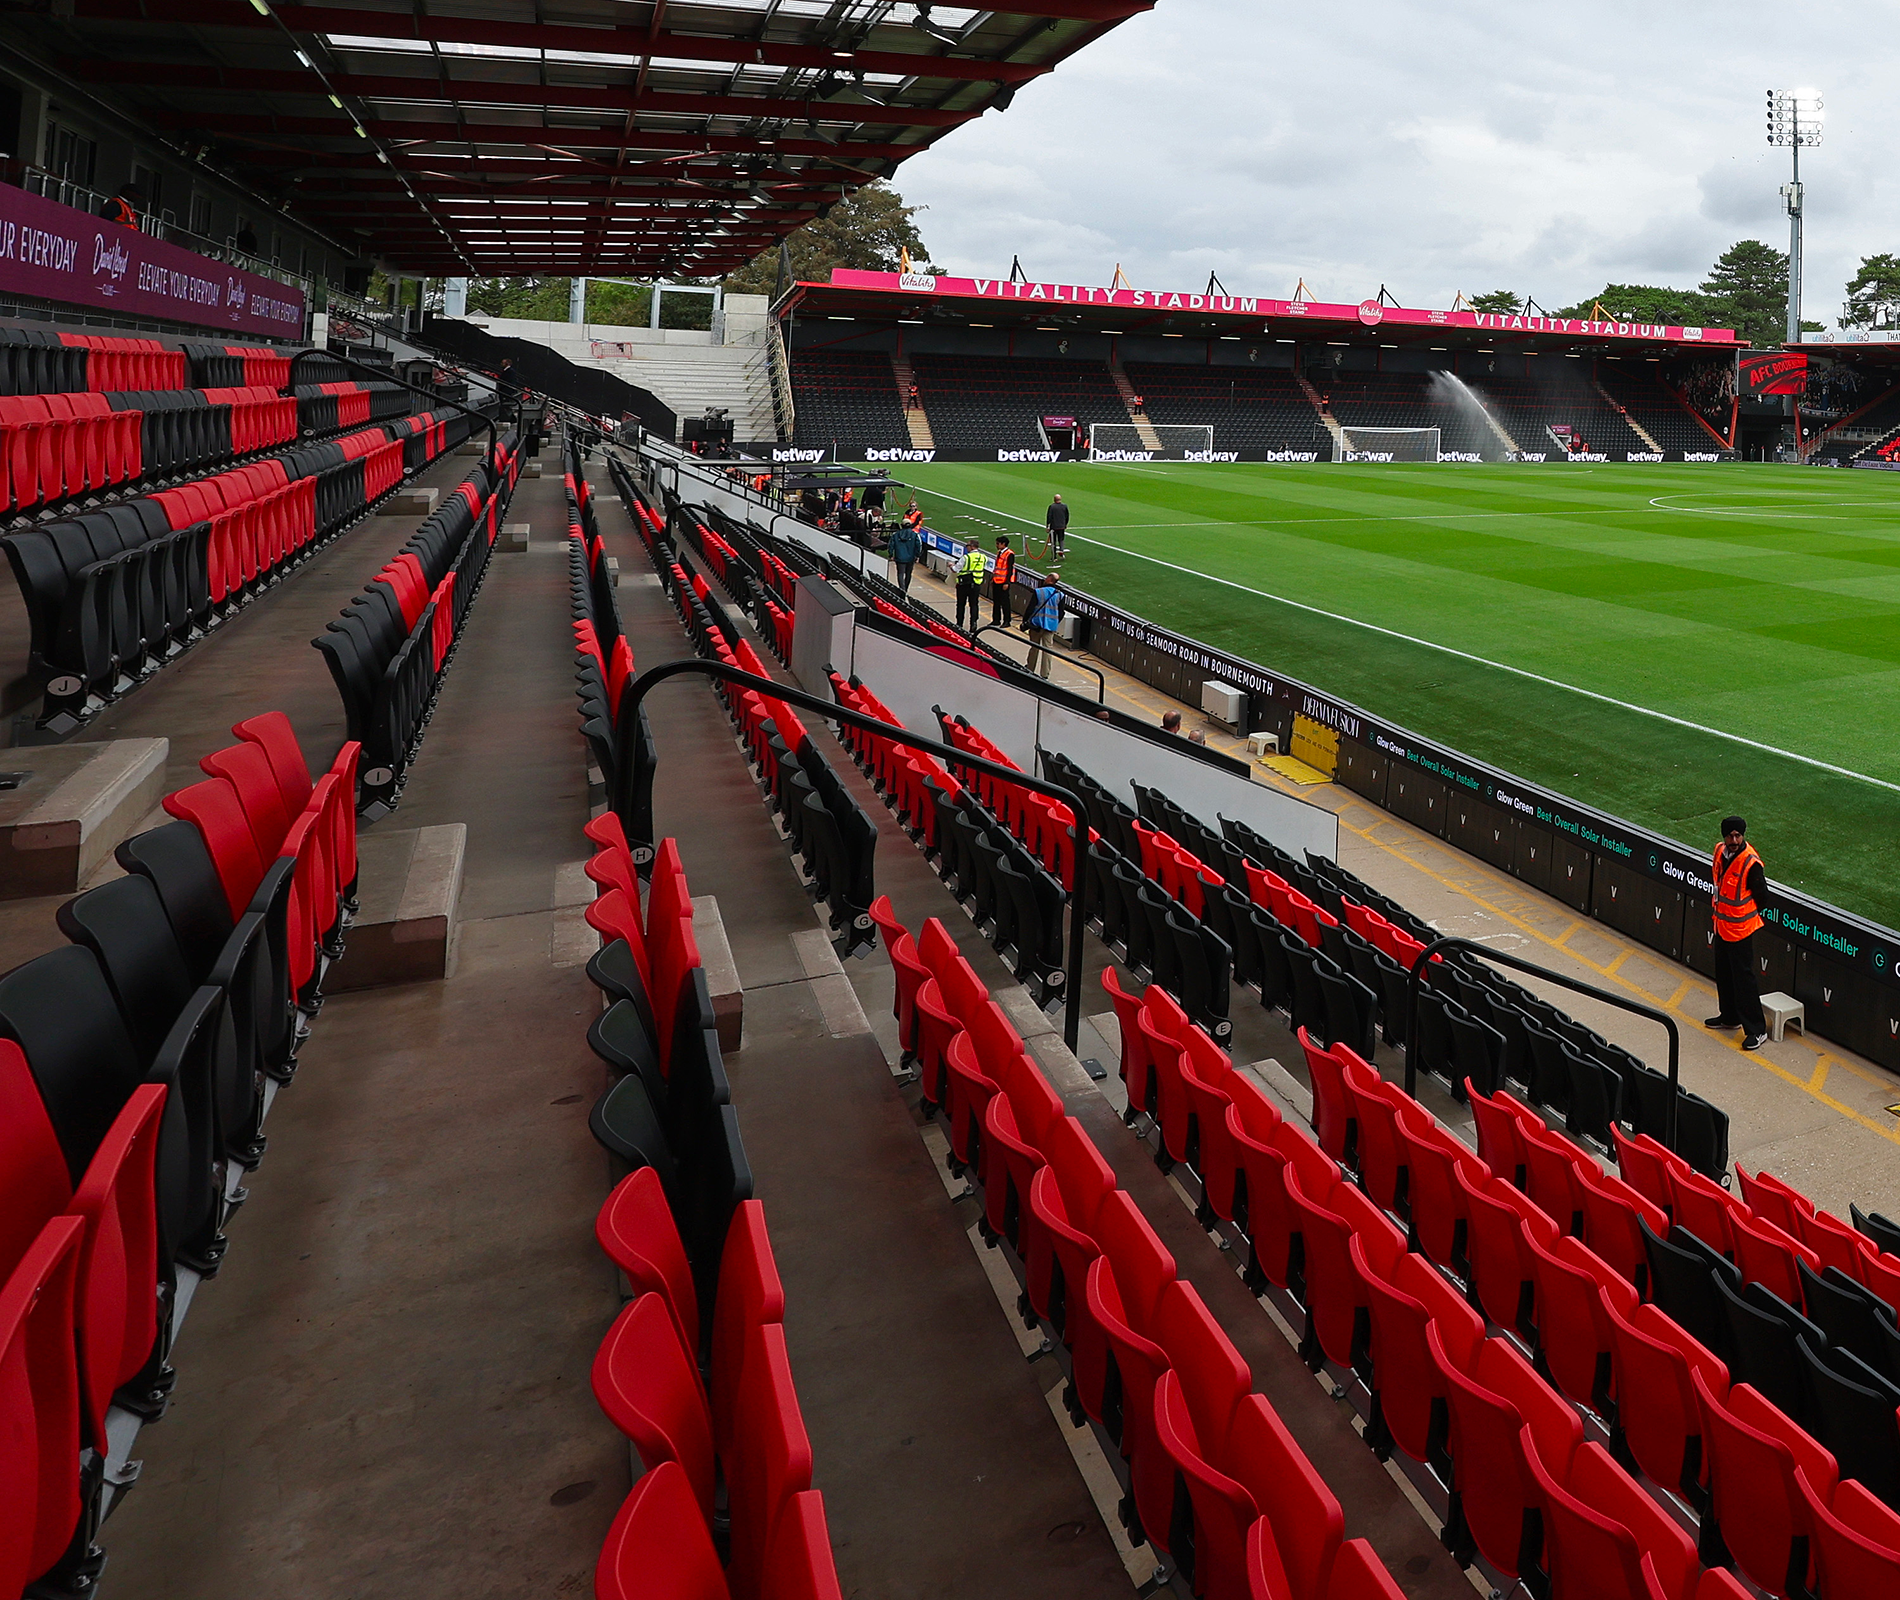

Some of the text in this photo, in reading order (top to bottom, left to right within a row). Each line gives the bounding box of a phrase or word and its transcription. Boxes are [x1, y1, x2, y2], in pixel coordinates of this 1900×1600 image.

[20, 226, 77, 273] EVERYDAY
[138, 261, 168, 296] ELEVATE
[170, 270, 188, 300] YOUR
[190, 276, 220, 307] EVERYDAY
[900, 274, 935, 292] Vitality
[974, 279, 1257, 312] VITALITY STADIUM
[1358, 304, 1383, 322] Vitality
[1474, 312, 1574, 332] VITALITY
[1580, 320, 1667, 338] STADIUM
[1750, 365, 1774, 387] AFC
[772, 448, 825, 464] betway
[867, 448, 936, 463] betway
[997, 449, 1060, 463] betway
[1095, 449, 1154, 462] betway
[1184, 449, 1239, 463] betway
[1266, 450, 1318, 463] betway
[1437, 450, 1480, 463] betway
[1568, 451, 1607, 463] betway
[1627, 451, 1664, 463] betway
[1684, 451, 1719, 463] betway
[1076, 600, 1099, 620] SKIN SPA
[1110, 615, 1274, 697] VISIT US SEAMOOR ROAD IN BOURNEMOUTH
[1376, 735, 1480, 791] Glow Green Best Overall Solar Installer
[1496, 789, 1633, 859] Glow Green Best Overall Solar Installer
[1662, 859, 1859, 958] Glow Green Solar Installer
